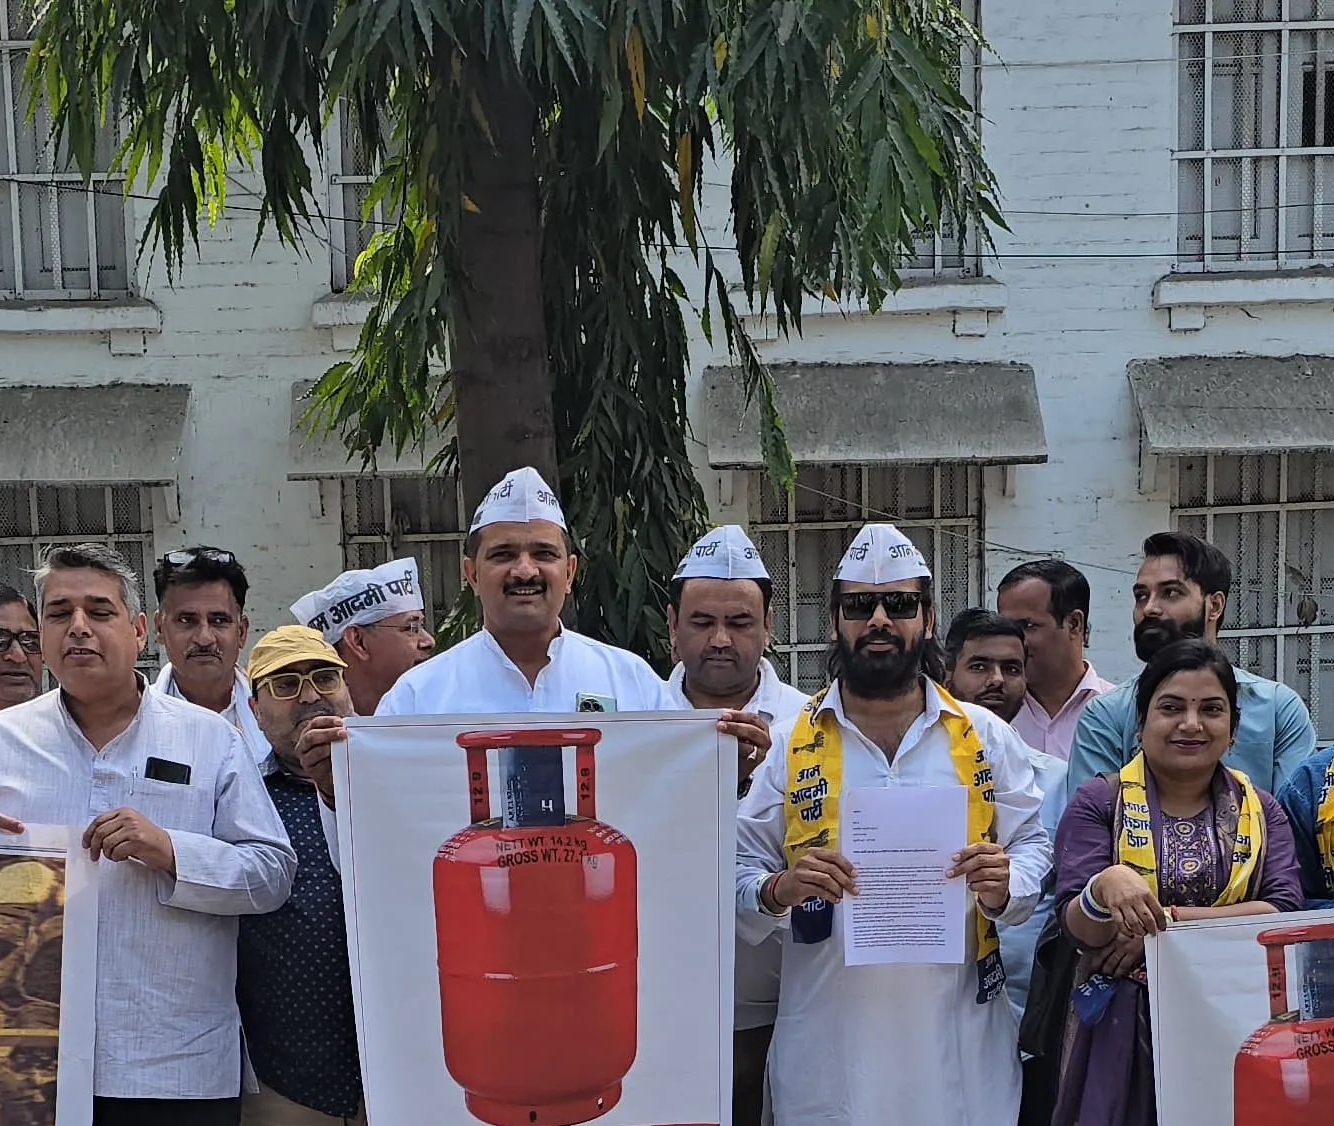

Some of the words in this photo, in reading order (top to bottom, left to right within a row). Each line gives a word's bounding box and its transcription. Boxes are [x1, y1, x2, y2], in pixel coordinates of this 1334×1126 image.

[329, 583, 387, 625] आदमी
[797, 764, 821, 782] आम
[790, 778, 829, 804] आदमी
[800, 798, 823, 822] पार्टी
[495, 838, 525, 853] NETT
[497, 849, 539, 869] GROSS
[540, 848, 562, 863] WT.
[1293, 1029, 1321, 1046] NETT
